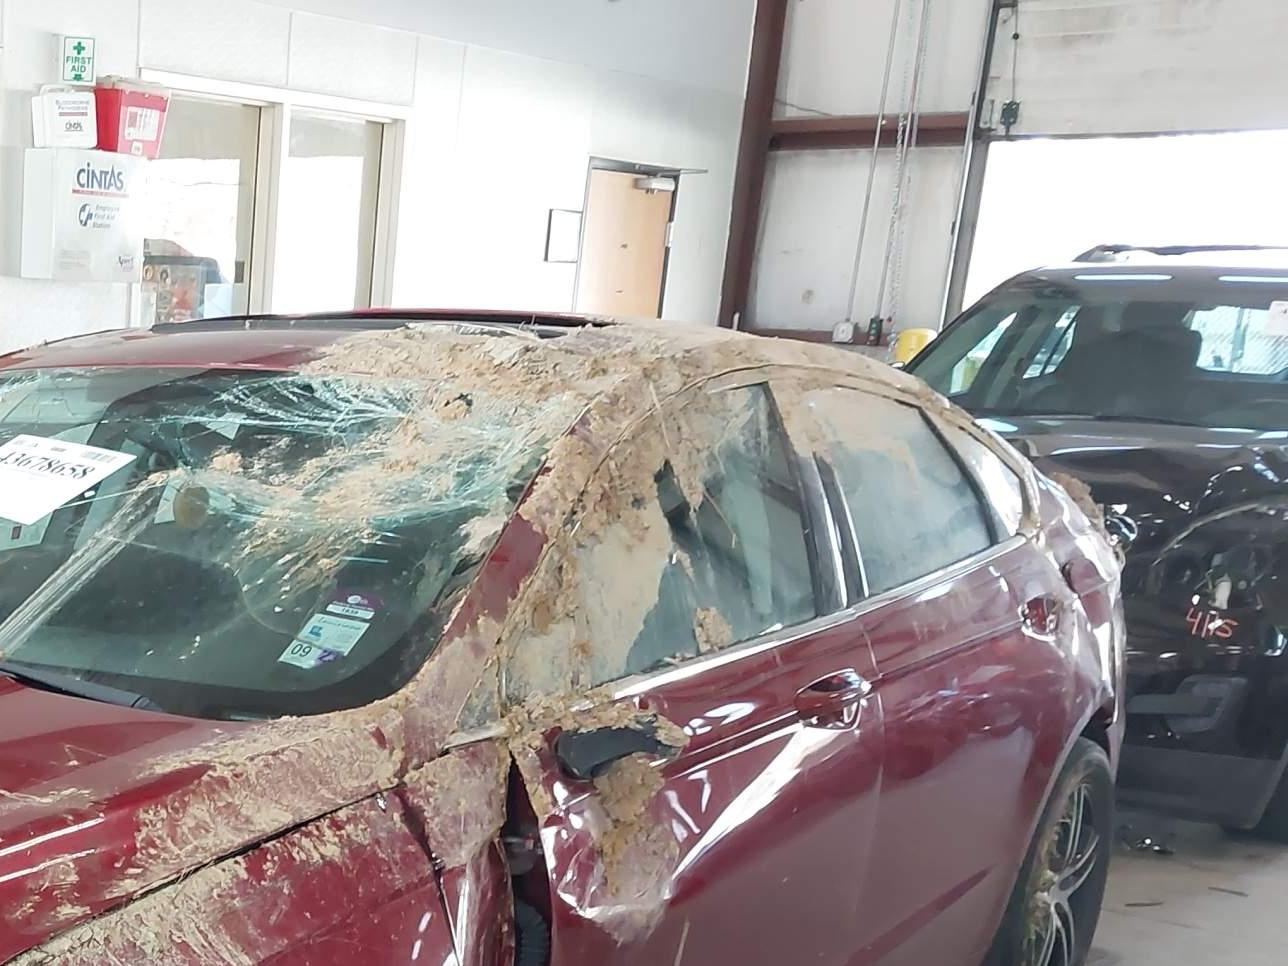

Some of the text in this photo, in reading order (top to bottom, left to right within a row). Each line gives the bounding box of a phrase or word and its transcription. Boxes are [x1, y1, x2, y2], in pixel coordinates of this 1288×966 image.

[65, 56, 92, 65] FIRST
[70, 65, 87, 73] AID
[76, 161, 124, 191] CINTAS
[290, 643, 312, 657] 09
